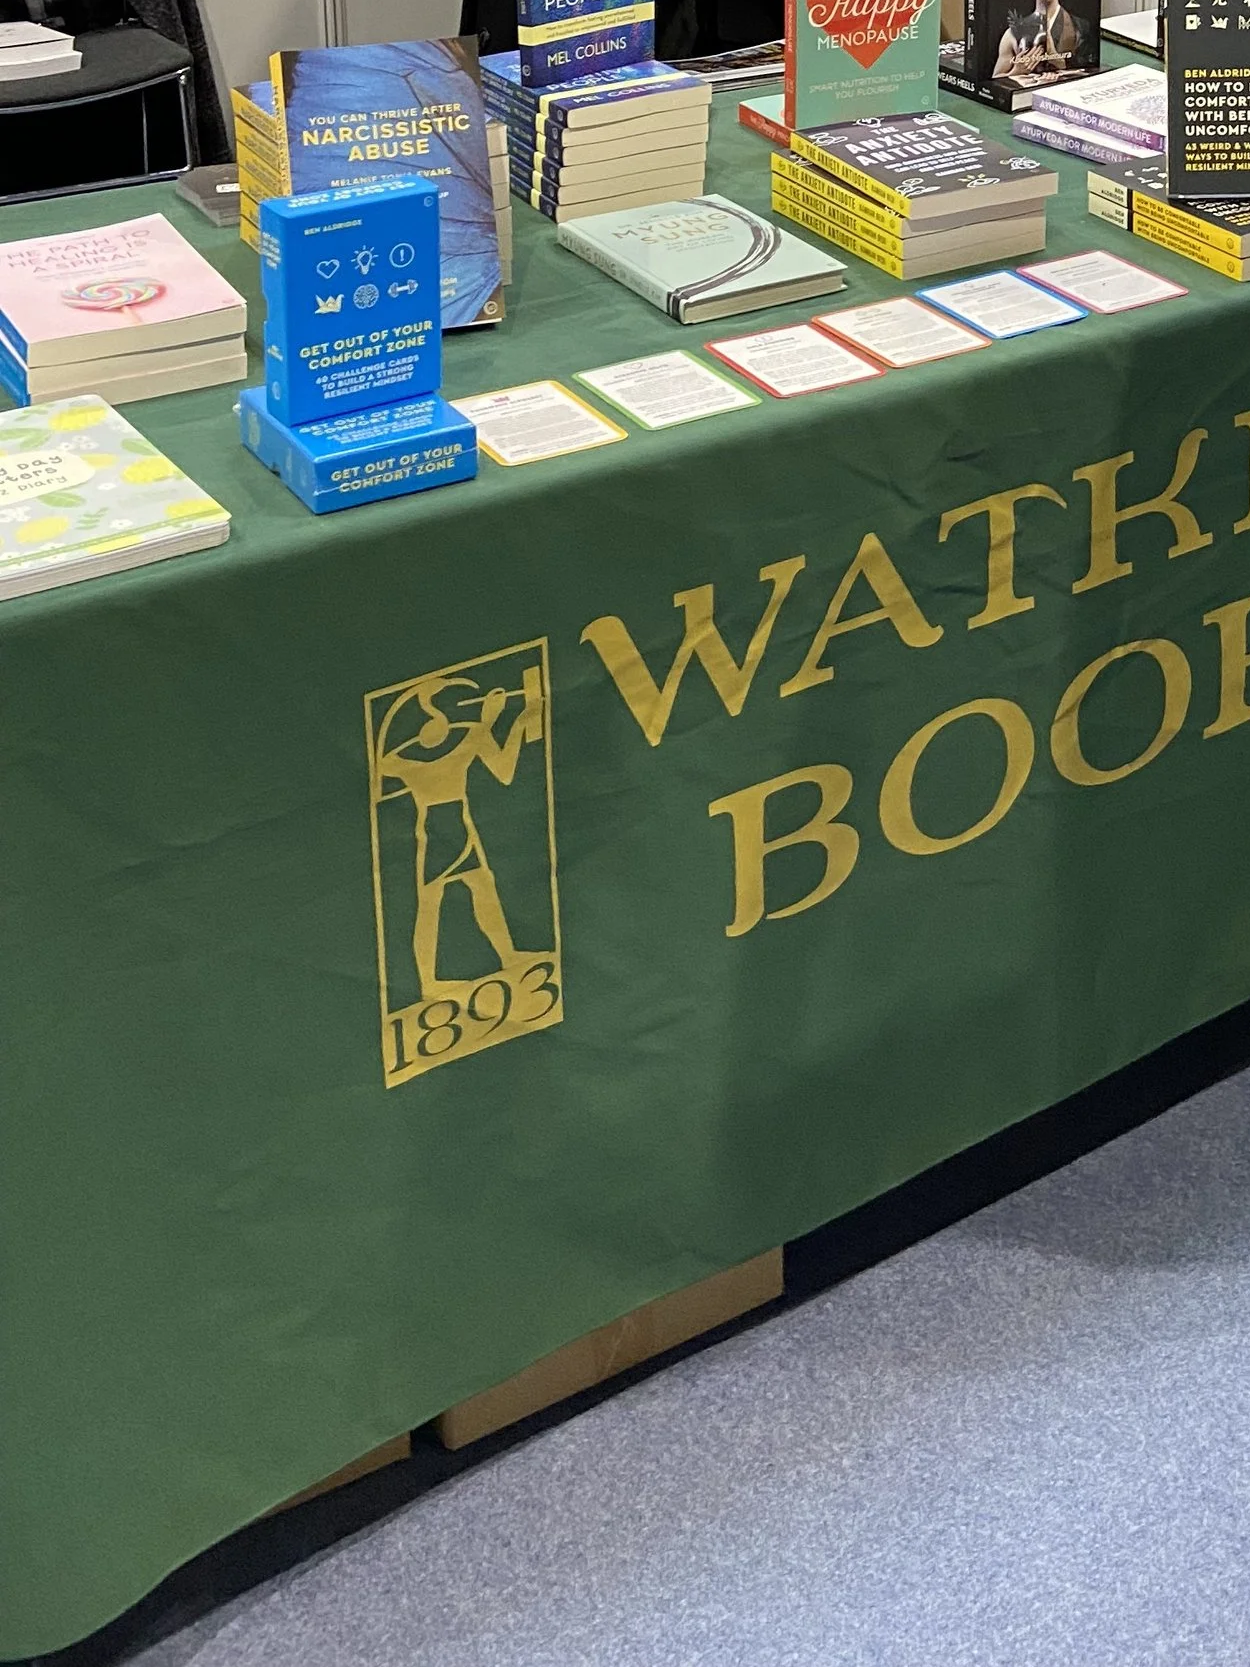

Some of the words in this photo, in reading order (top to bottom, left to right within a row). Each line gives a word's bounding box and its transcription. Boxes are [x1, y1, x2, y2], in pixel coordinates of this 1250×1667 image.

[817, 25, 919, 51] MENOPAUSE
[547, 53, 571, 68] MEL
[575, 37, 627, 61] COLLINS
[809, 82, 838, 94] SMART
[841, 76, 888, 89] NUTRITION
[890, 72, 902, 82] TO
[904, 70, 925, 81] HELP
[957, 77, 975, 92] HEELS
[1184, 69, 1207, 78] BEN
[836, 89, 853, 99] YOU
[857, 84, 899, 97] FLOURISH
[1184, 82, 1221, 93] HOW
[1224, 82, 1244, 93] TO
[308, 114, 335, 126] YOU
[340, 112, 367, 123] CAN
[372, 107, 418, 121] THRIVE
[421, 103, 461, 115] AFTER
[1039, 99, 1080, 120] AYURVEDA
[1081, 112, 1097, 125] FOR
[1098, 118, 1133, 138] MODERN
[1134, 130, 1151, 143] LIFE
[1185, 110, 1223, 122] WITH
[302, 114, 471, 146] NARCISSISTIC
[845, 126, 954, 154] ANXIETY
[870, 126, 899, 135] THE
[348, 138, 430, 162] ABUSE
[856, 134, 984, 166] ANTIDOTE
[1021, 125, 1062, 145] AYURVEDA
[1063, 137, 1080, 151] FOR
[1082, 142, 1117, 162] MODERN
[1185, 142, 1197, 151] 43
[1199, 142, 1231, 151] WEIRD
[1234, 142, 1241, 150] &
[1186, 152, 1212, 161] WAYS
[1213, 152, 1228, 160] TO
[806, 145, 817, 159] THE
[818, 151, 840, 171] ANXIETY
[841, 165, 868, 191] ANTIDOTE
[1185, 162, 1234, 171] RESILIENT
[788, 164, 799, 179] THE
[801, 172, 825, 195] ANXIETY
[827, 186, 856, 210] ANTIDOTE
[789, 185, 800, 200] THE
[802, 191, 826, 214] ANXIETY
[828, 206, 857, 231] ANTIDOTE
[612, 213, 728, 238] MYUNG
[640, 224, 729, 244] SUNG
[789, 204, 800, 220] THE
[801, 211, 826, 235] ANXIETY
[828, 228, 857, 251] ANTIDOTE
[8, 246, 118, 268] HEALING
[126, 240, 147, 248] IS
[49, 238, 110, 253] PATH
[121, 230, 150, 241] TO
[56, 251, 140, 268] SPIRAL
[300, 343, 329, 358] GET
[334, 335, 365, 350] OUT
[369, 330, 389, 343] OF
[392, 320, 433, 337] YOUR
[309, 345, 382, 370] COMFORT
[386, 335, 426, 353] ZONE
[322, 382, 335, 391] TO
[337, 375, 365, 388] BUILD
[367, 373, 375, 381] A
[377, 364, 414, 379] STRONG
[331, 362, 385, 380] CHALLENGE
[388, 354, 419, 368] CARDS
[324, 382, 371, 399] RESILIENT
[372, 372, 413, 388] MINDSET
[331, 466, 360, 482] GET
[365, 458, 394, 473] OUT
[399, 452, 419, 465] OF
[423, 443, 463, 460] YOUR
[339, 469, 410, 493] COMFORT
[416, 457, 455, 476] ZONE
[389, 962, 560, 1074] 1893
